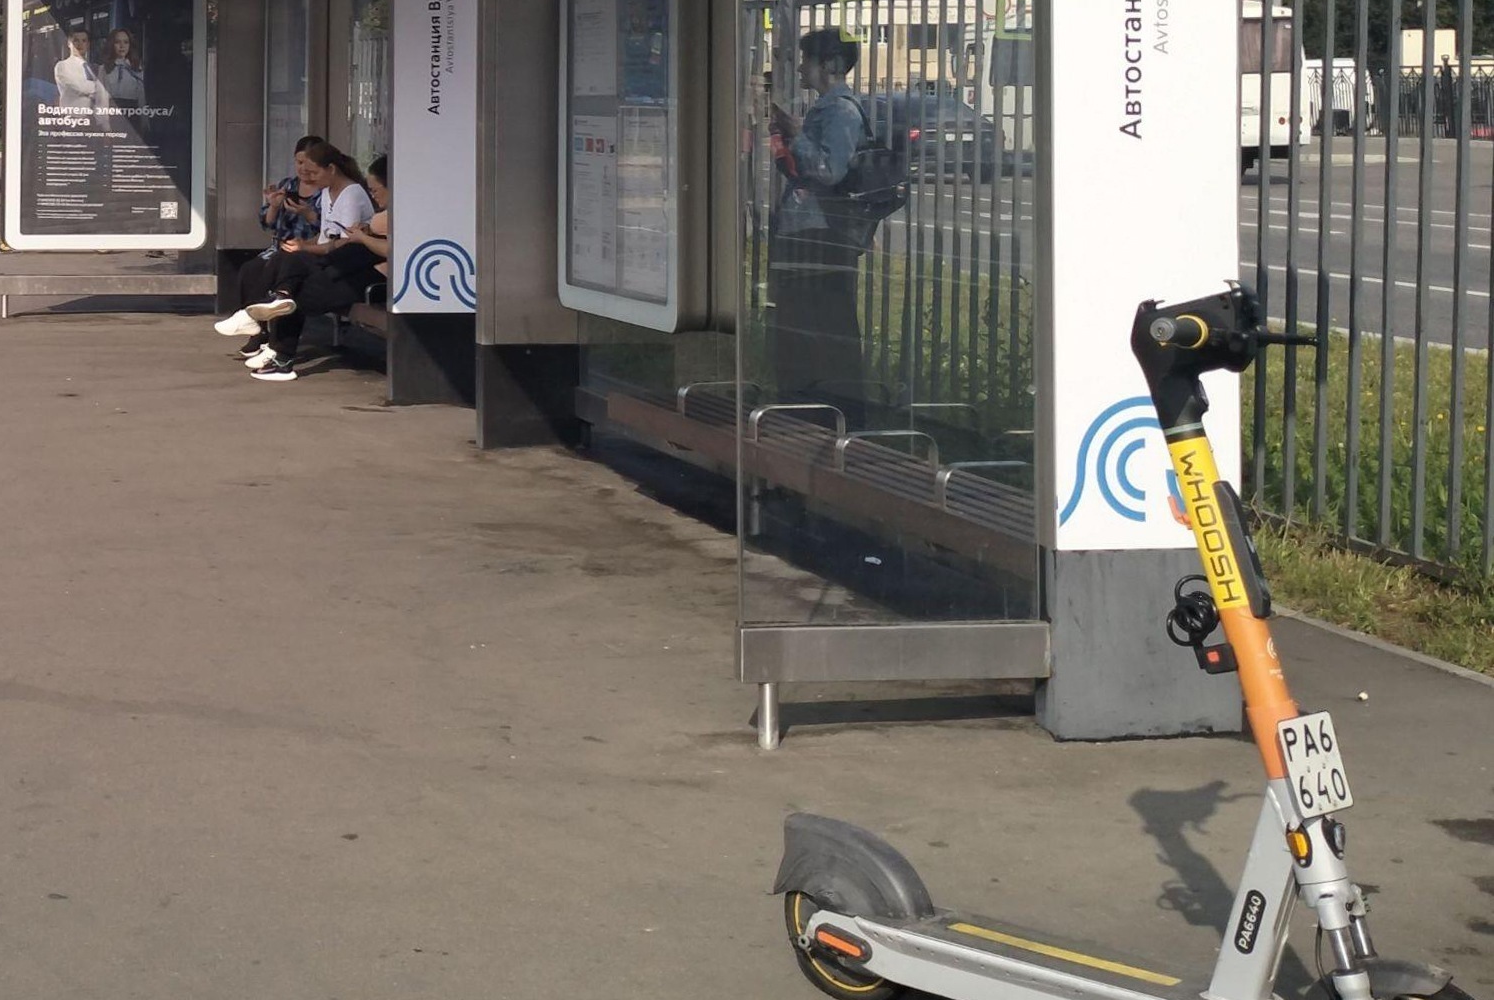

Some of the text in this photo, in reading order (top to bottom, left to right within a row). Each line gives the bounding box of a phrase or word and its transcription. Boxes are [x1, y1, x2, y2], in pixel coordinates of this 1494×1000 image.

[445, 4, 456, 74] Avtostantsiya
[427, 15, 443, 116] Автостанция
[37, 103, 175, 118] Водитель электробуса/
[37, 115, 91, 128] автобуса
[1180, 450, 1242, 602] WHOOSH
[1283, 719, 1333, 762] PA6
[1299, 768, 1347, 808] 640
[1238, 895, 1262, 950] PA6640
